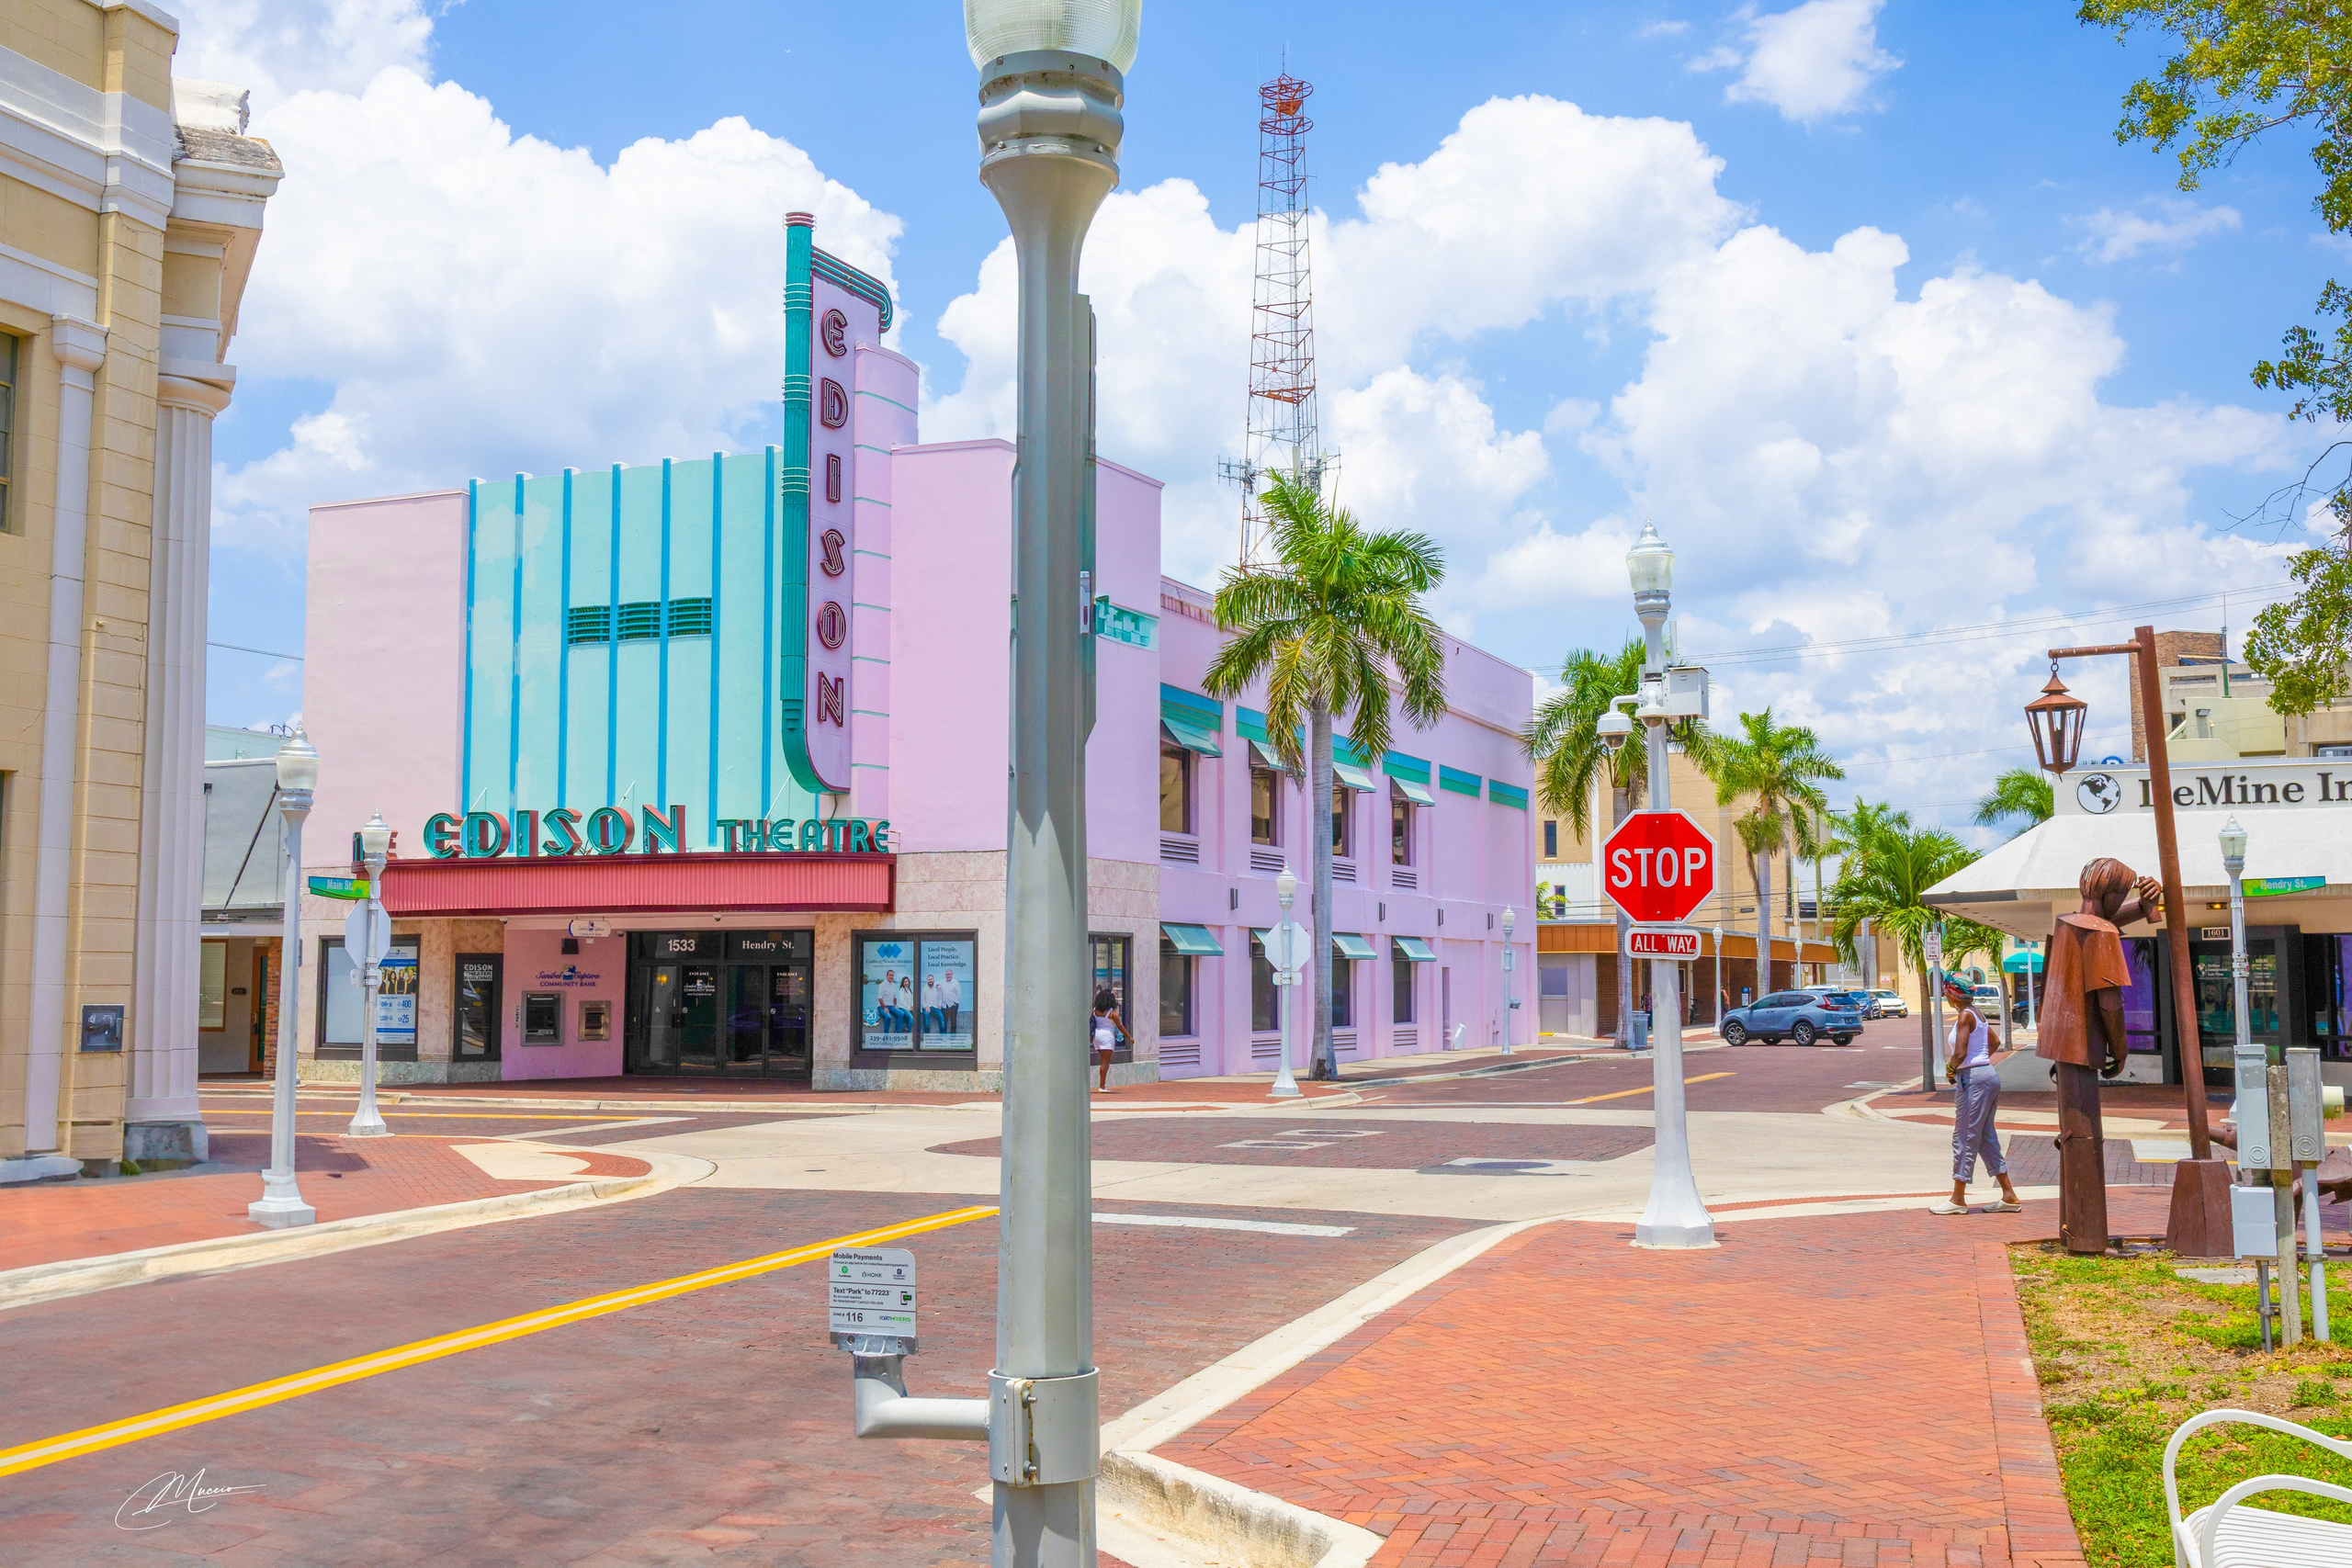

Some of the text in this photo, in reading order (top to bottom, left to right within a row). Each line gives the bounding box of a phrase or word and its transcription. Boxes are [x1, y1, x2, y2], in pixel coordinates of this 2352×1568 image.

[817, 308, 847, 728] EDISON
[423, 804, 686, 859] EDISON
[718, 818, 891, 853] THEATRE
[1611, 847, 1707, 888] STOP
[327, 879, 354, 891] Main St.
[2260, 878, 2307, 891] Hendry St.
[667, 939, 696, 952] 1533
[741, 940, 795, 952] Hendry St.
[1634, 935, 1693, 953] ALL WAY
[536, 971, 601, 981] Sanibel Captiva
[401, 999, 412, 1008] 400
[402, 1014, 410, 1023] 25
[866, 1011, 876, 1020] 20
[854, 1253, 883, 1261] Payments
[846, 1312, 864, 1322] 116
